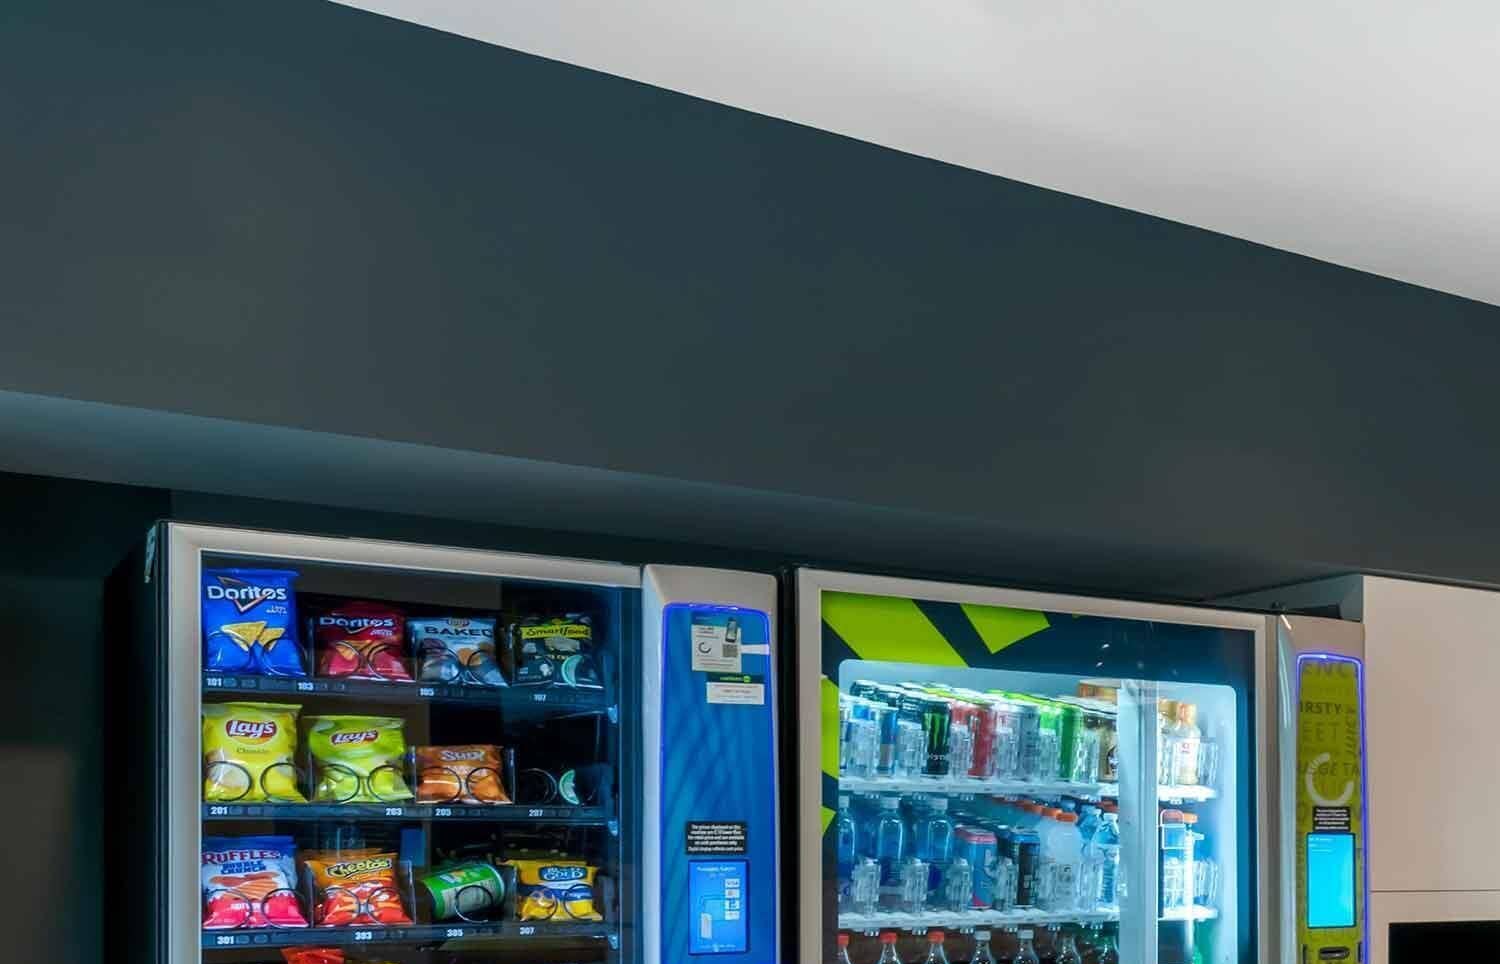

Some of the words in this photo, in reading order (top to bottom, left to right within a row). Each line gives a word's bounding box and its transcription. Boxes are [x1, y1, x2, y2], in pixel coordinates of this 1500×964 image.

[207, 585, 287, 601] Doritos
[319, 616, 394, 627] Doritos
[201, 850, 281, 864] RUFFLES
[329, 859, 391, 877] Cheetos
